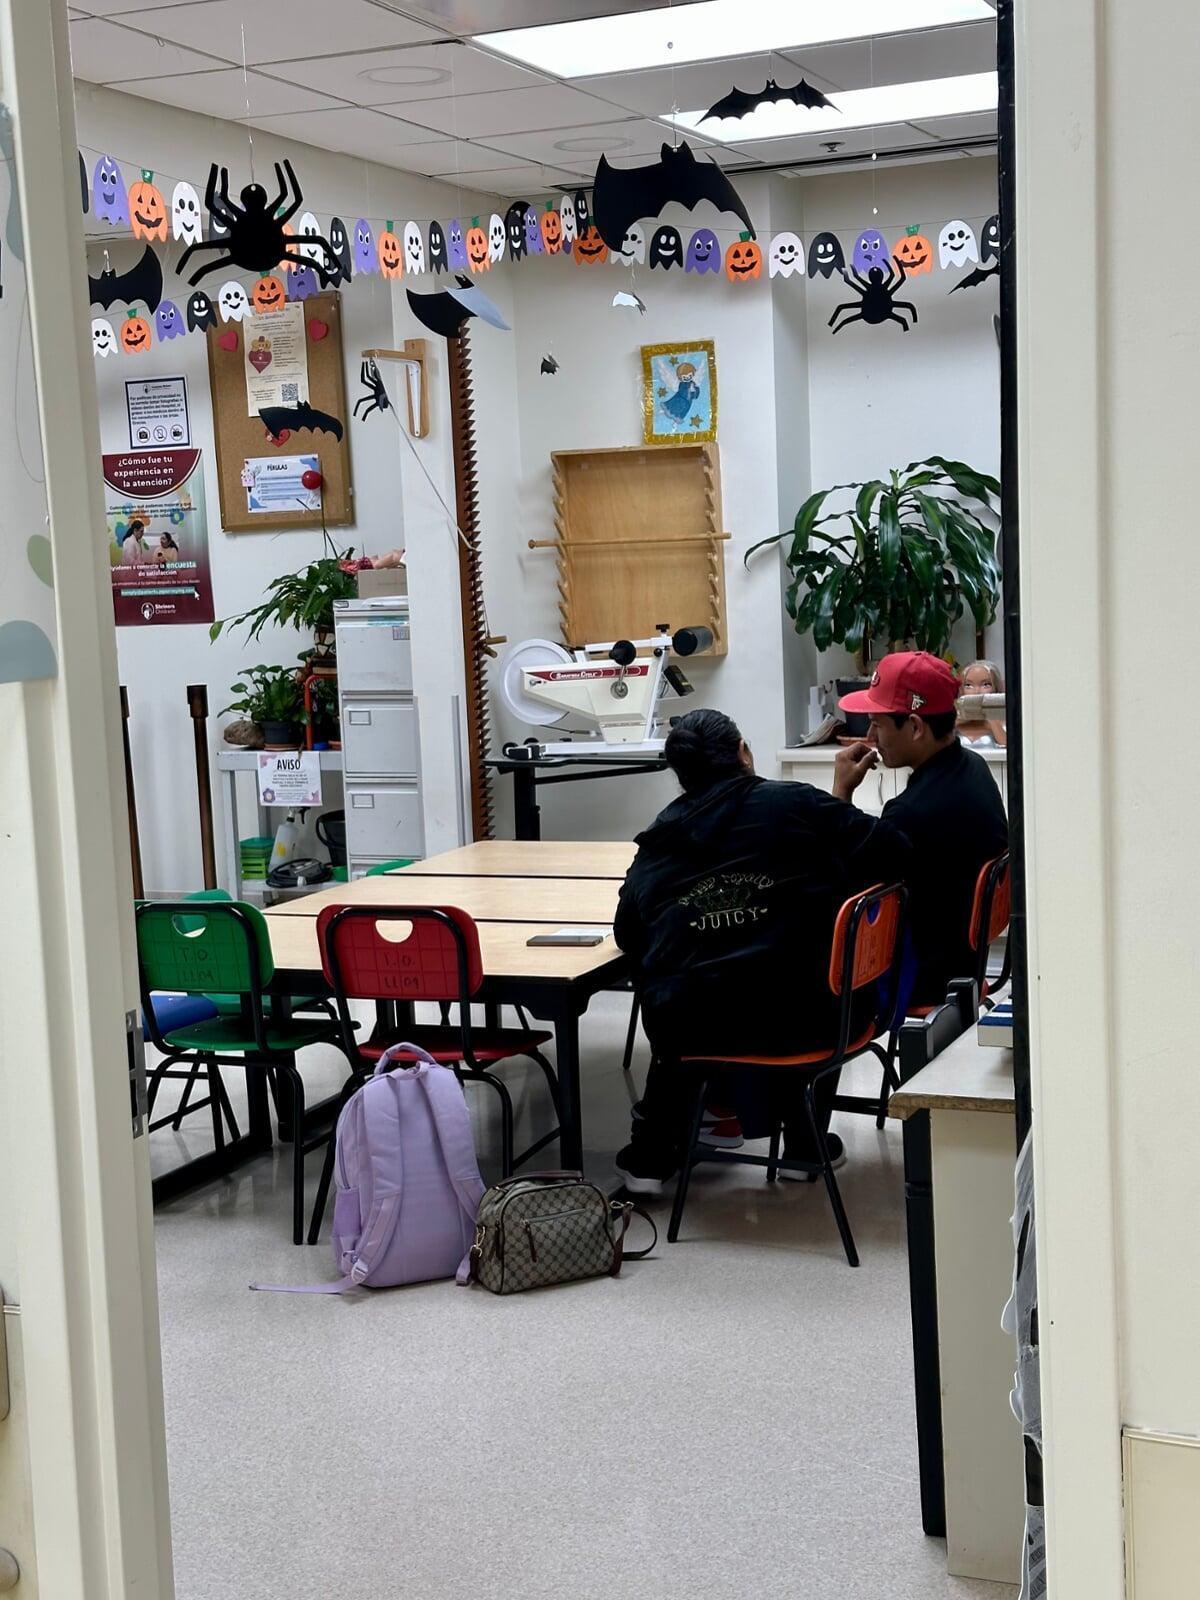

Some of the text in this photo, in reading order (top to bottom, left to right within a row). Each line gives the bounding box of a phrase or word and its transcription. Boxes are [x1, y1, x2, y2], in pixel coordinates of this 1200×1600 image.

[118, 457, 146, 467] ¿Cómo
[114, 468, 161, 478] experiencia
[132, 478, 173, 487] atención?
